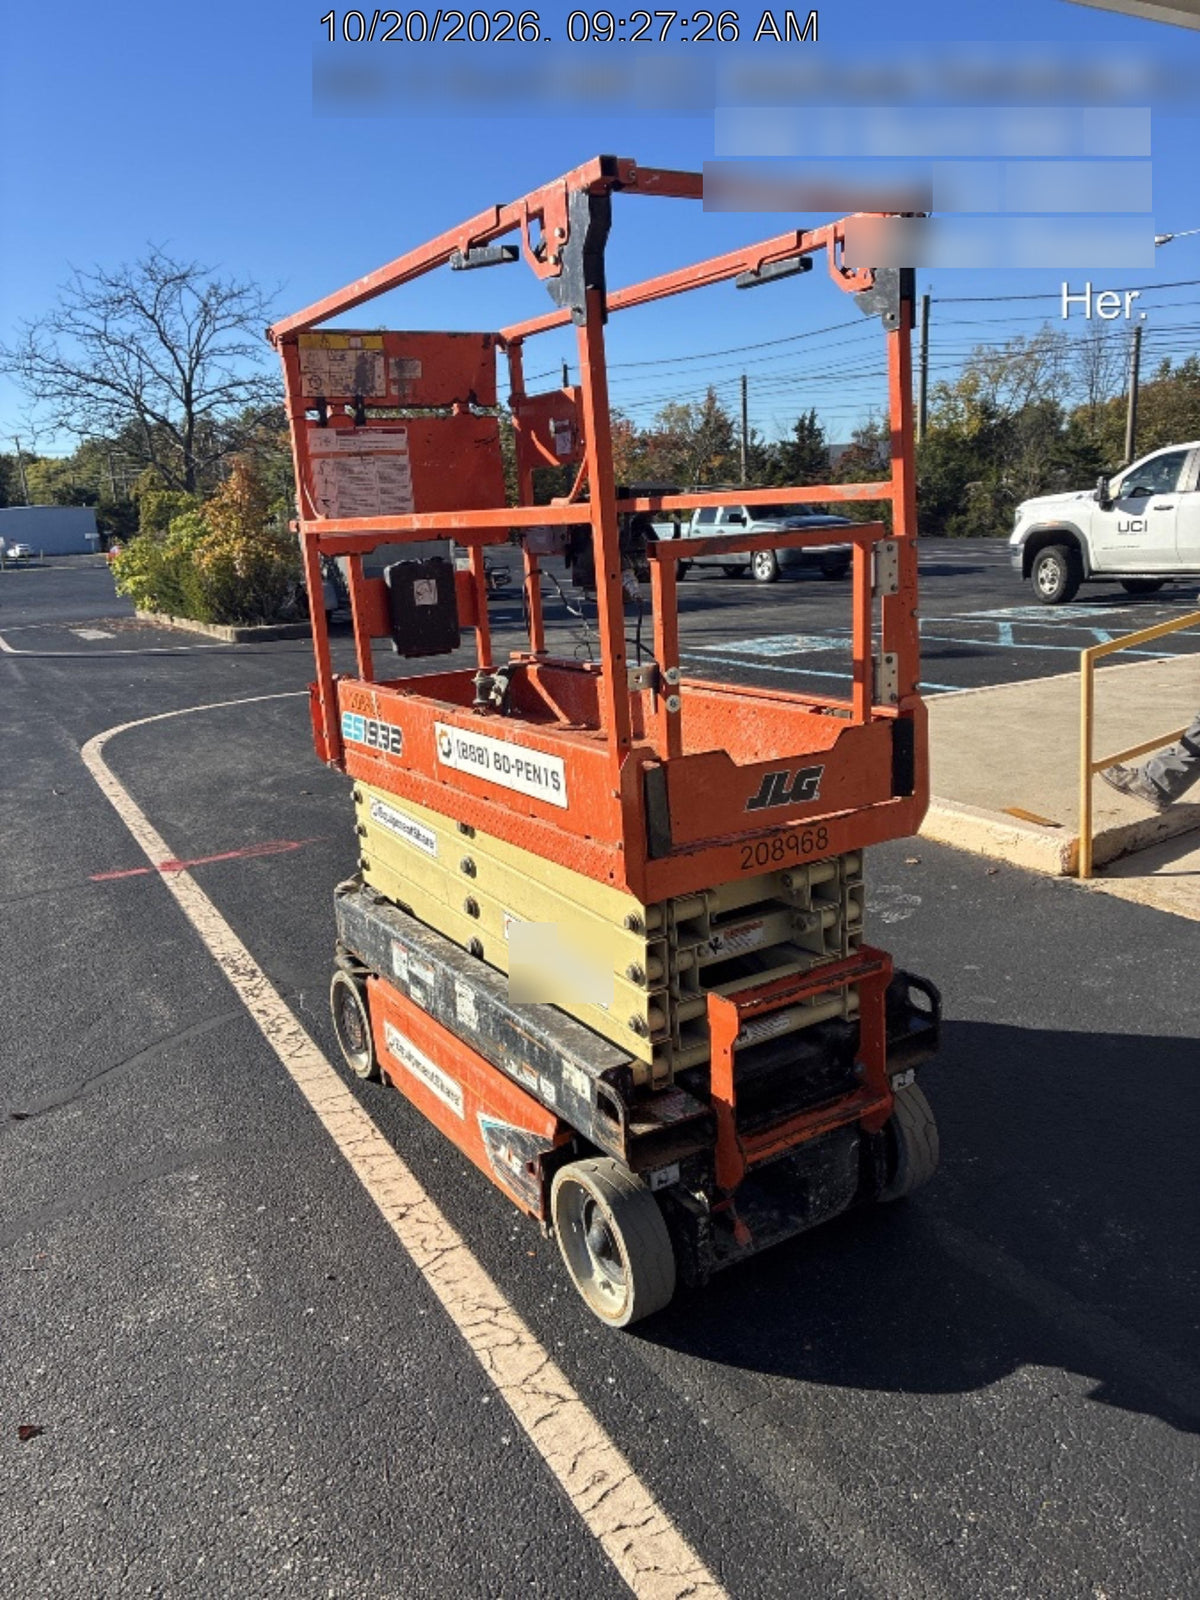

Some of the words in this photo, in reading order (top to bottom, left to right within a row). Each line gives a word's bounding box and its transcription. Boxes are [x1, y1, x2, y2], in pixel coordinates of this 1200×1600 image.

[1117, 519, 1148, 533] UCI
[343, 713, 402, 755] ES1932
[744, 764, 825, 812] JLG
[740, 827, 829, 870] 208968
